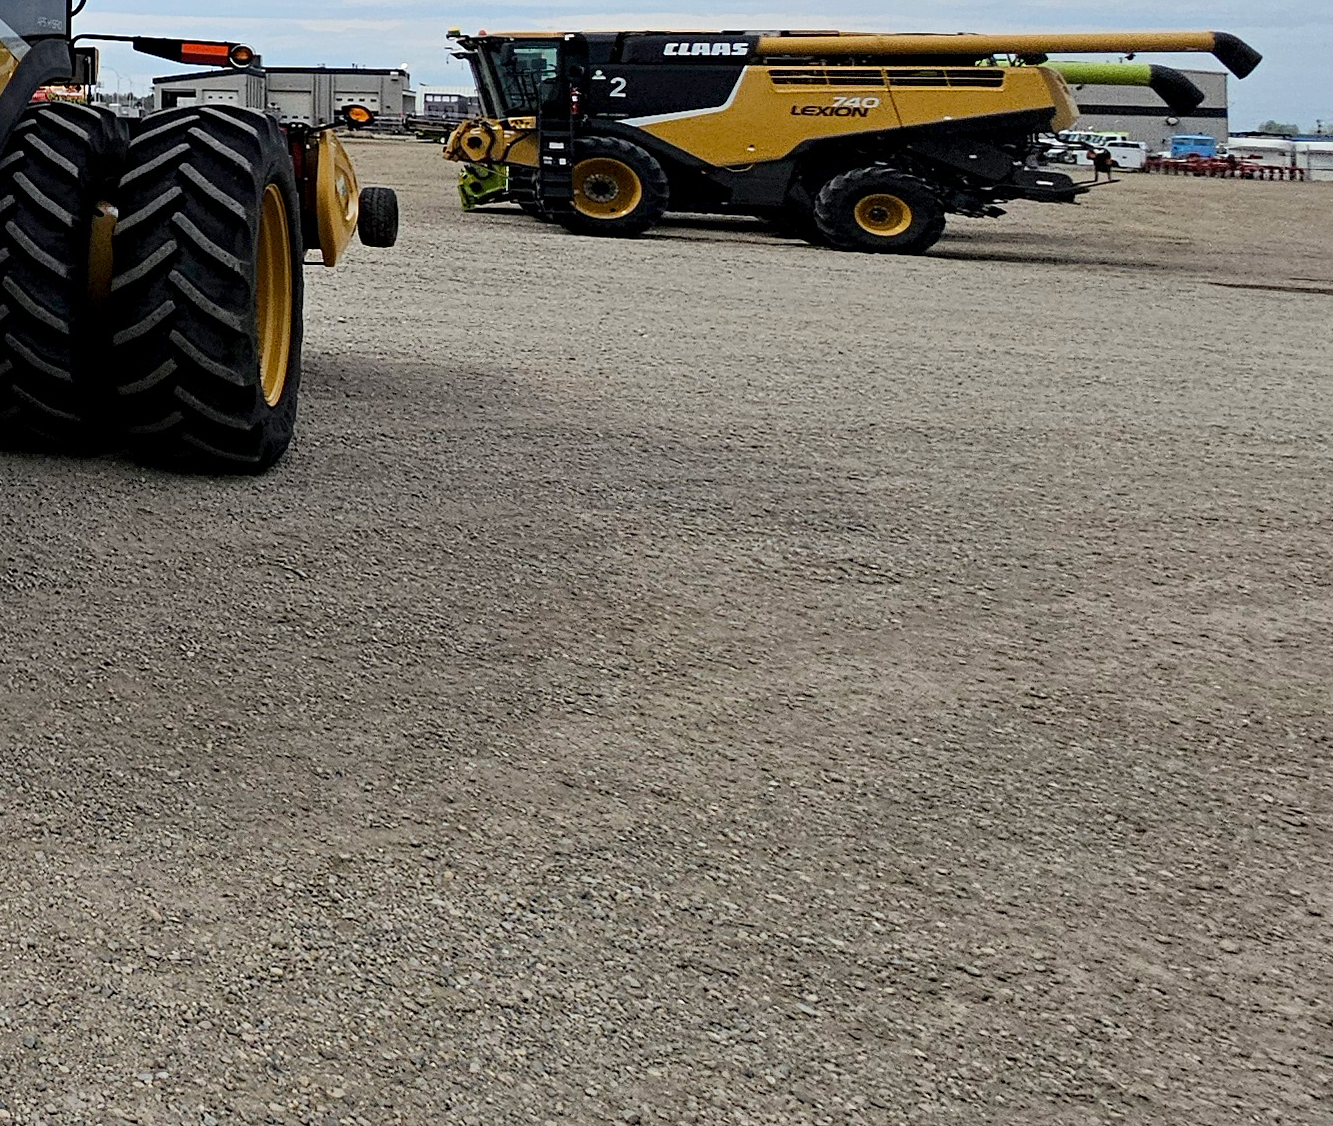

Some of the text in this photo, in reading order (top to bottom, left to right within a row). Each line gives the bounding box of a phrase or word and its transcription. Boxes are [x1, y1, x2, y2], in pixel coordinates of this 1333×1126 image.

[663, 42, 749, 56] CLAAS
[609, 77, 627, 98] 2
[833, 96, 881, 108] 740
[790, 105, 869, 118] LEXION
